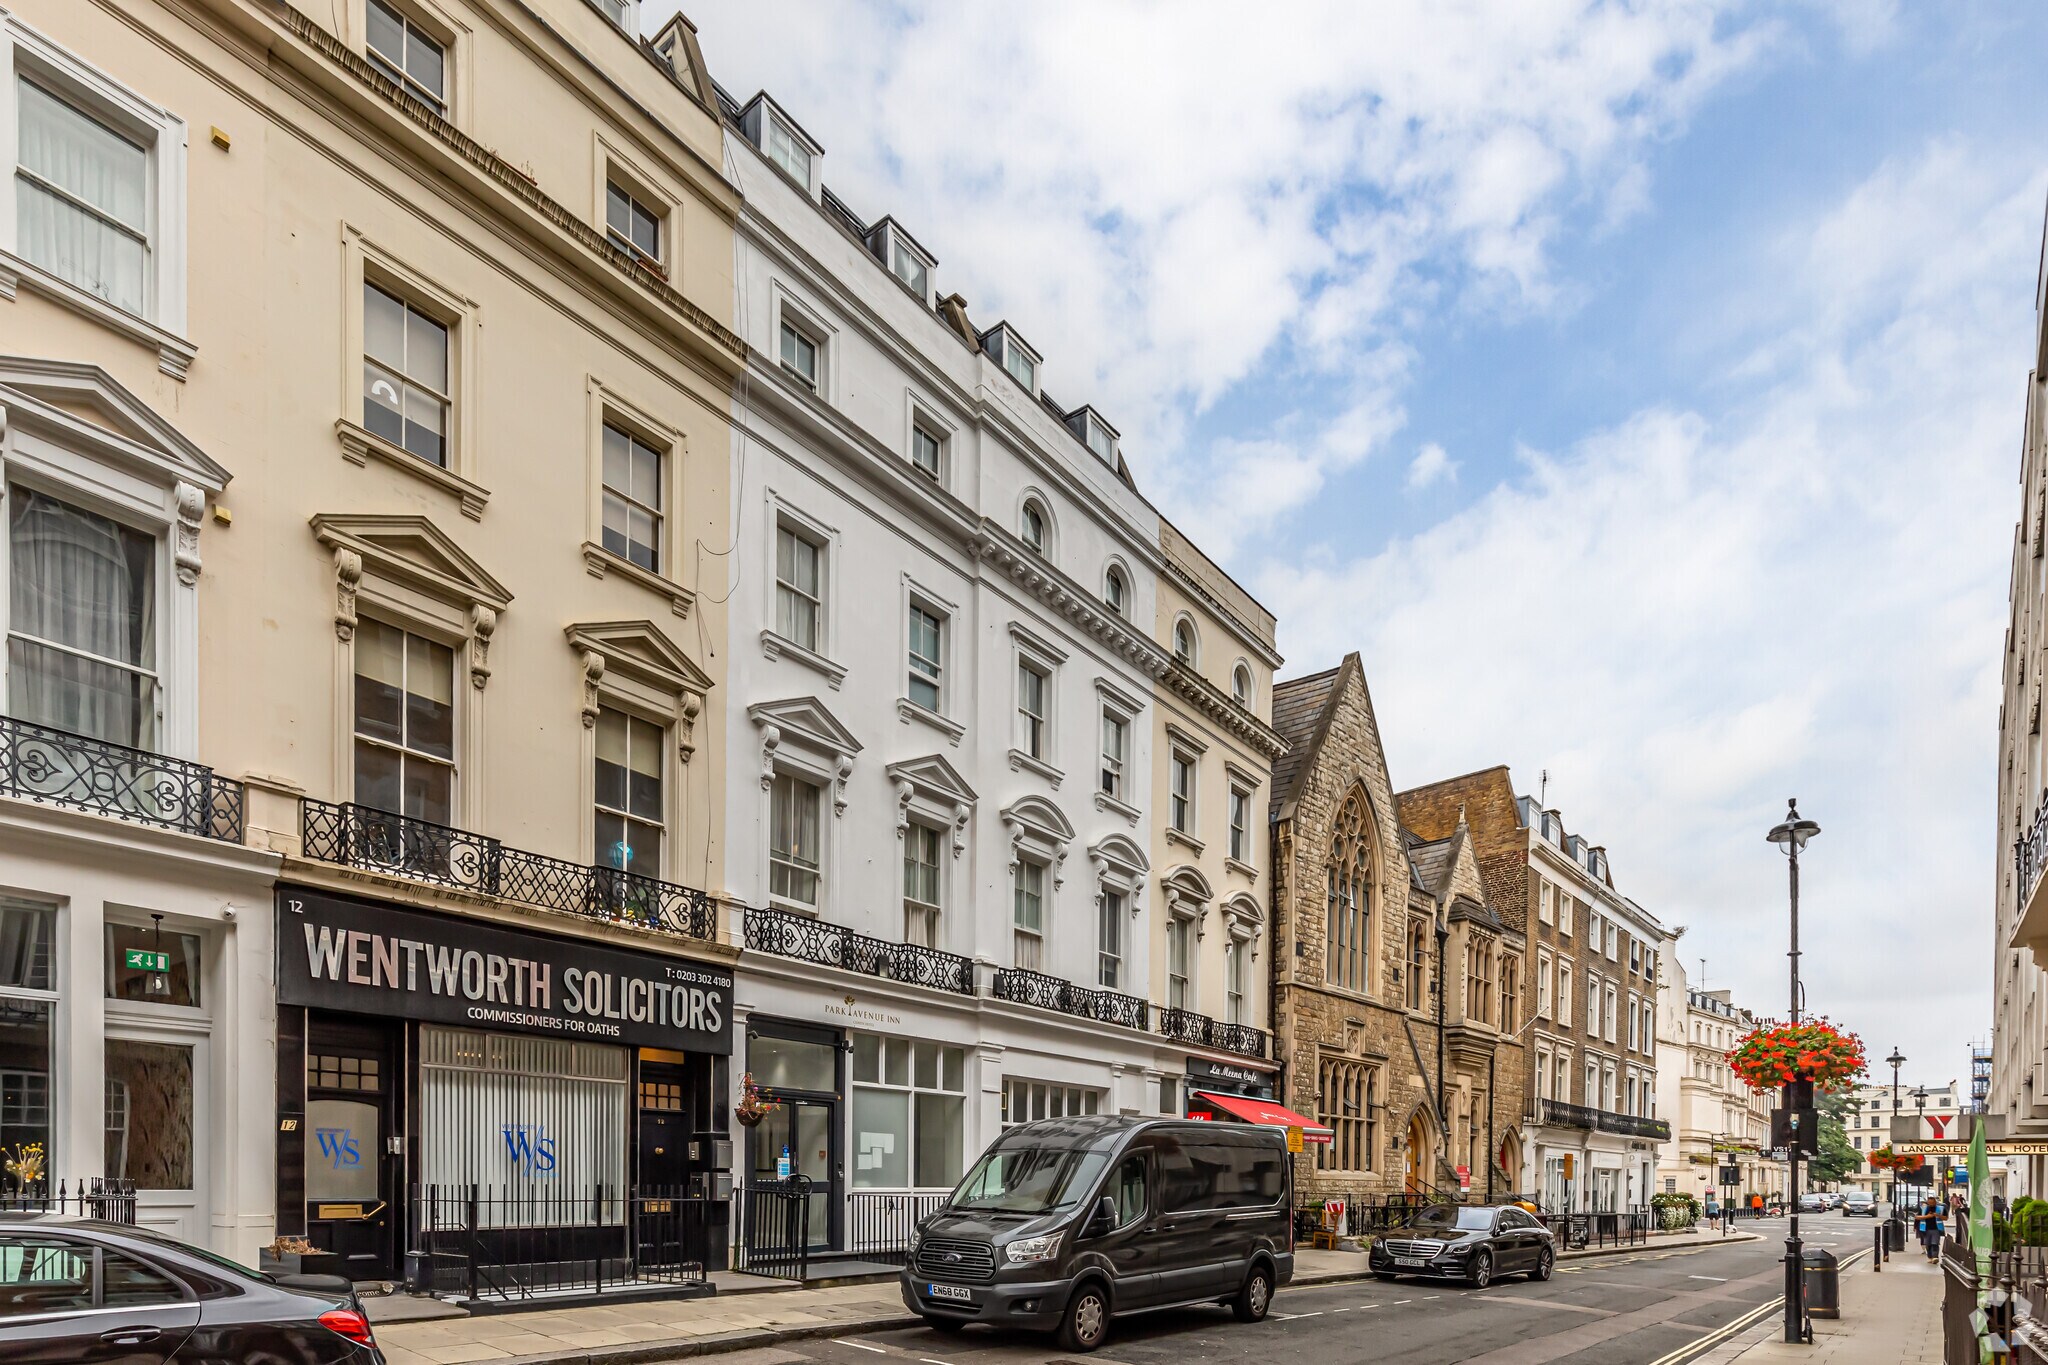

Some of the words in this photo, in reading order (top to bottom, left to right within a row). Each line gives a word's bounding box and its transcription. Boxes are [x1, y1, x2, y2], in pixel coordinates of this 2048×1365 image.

[288, 899, 304, 914] 12
[303, 922, 551, 1010] WENTWORTH
[562, 967, 723, 1033] SOLICITORS
[676, 969, 696, 982] 0203
[697, 973, 712, 985] 302
[713, 976, 731, 988] 4180
[466, 1007, 562, 1030] COMMISSIONERS
[564, 1020, 585, 1032] FOR
[587, 1024, 620, 1037] OATHS
[825, 1004, 846, 1015] PARK
[853, 1010, 885, 1022] AVENUE
[887, 1015, 901, 1024] INN
[1209, 1064, 1220, 1075] La
[282, 1120, 297, 1131] 12
[1901, 1145, 1968, 1153] LANCASTER
[1985, 1145, 2006, 1153] ALL
